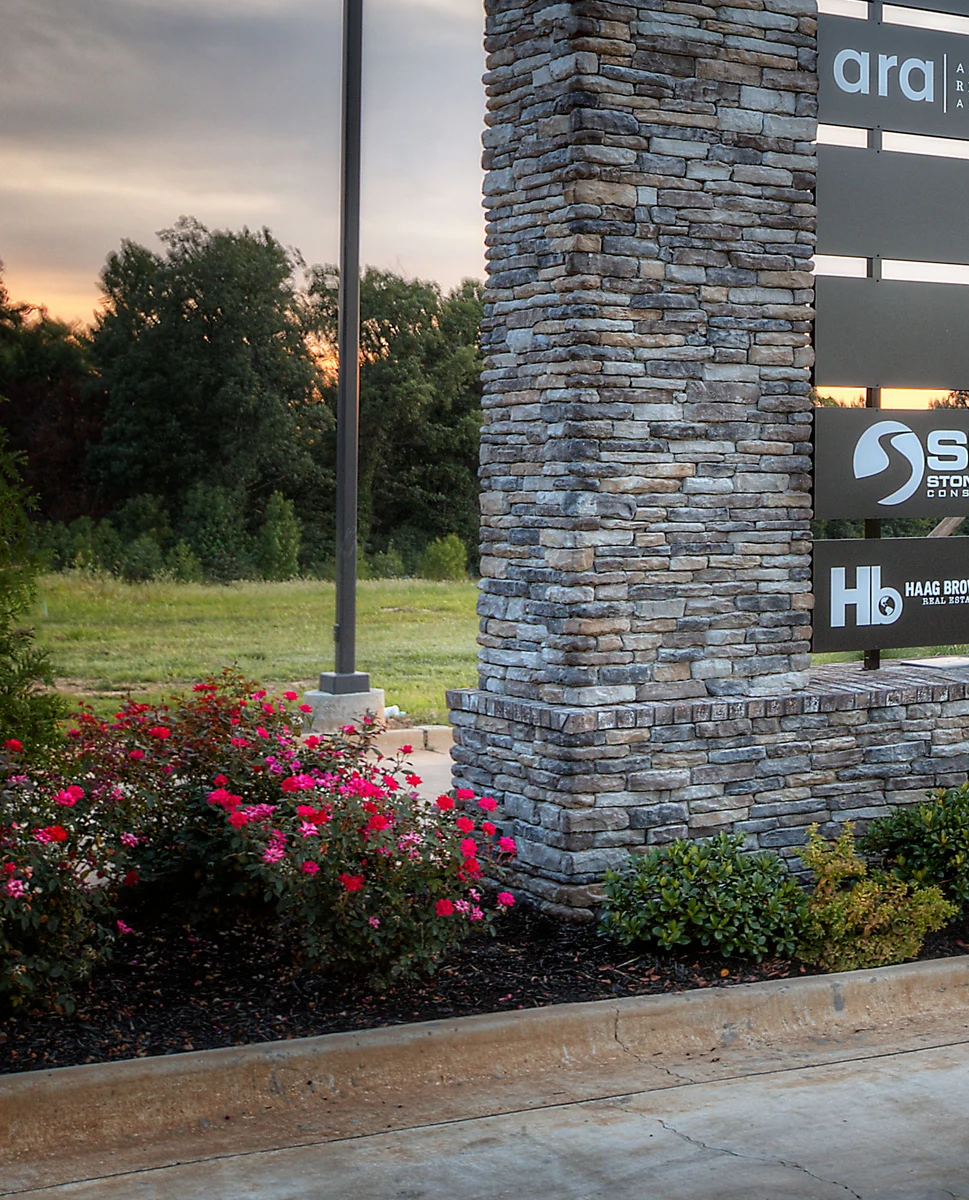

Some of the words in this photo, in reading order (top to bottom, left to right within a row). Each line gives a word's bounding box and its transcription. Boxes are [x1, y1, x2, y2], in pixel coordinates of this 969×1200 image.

[833, 48, 935, 103] ara
[830, 565, 903, 628] Hb
[905, 580, 941, 597] HAAG
[922, 596, 946, 605] REAL
